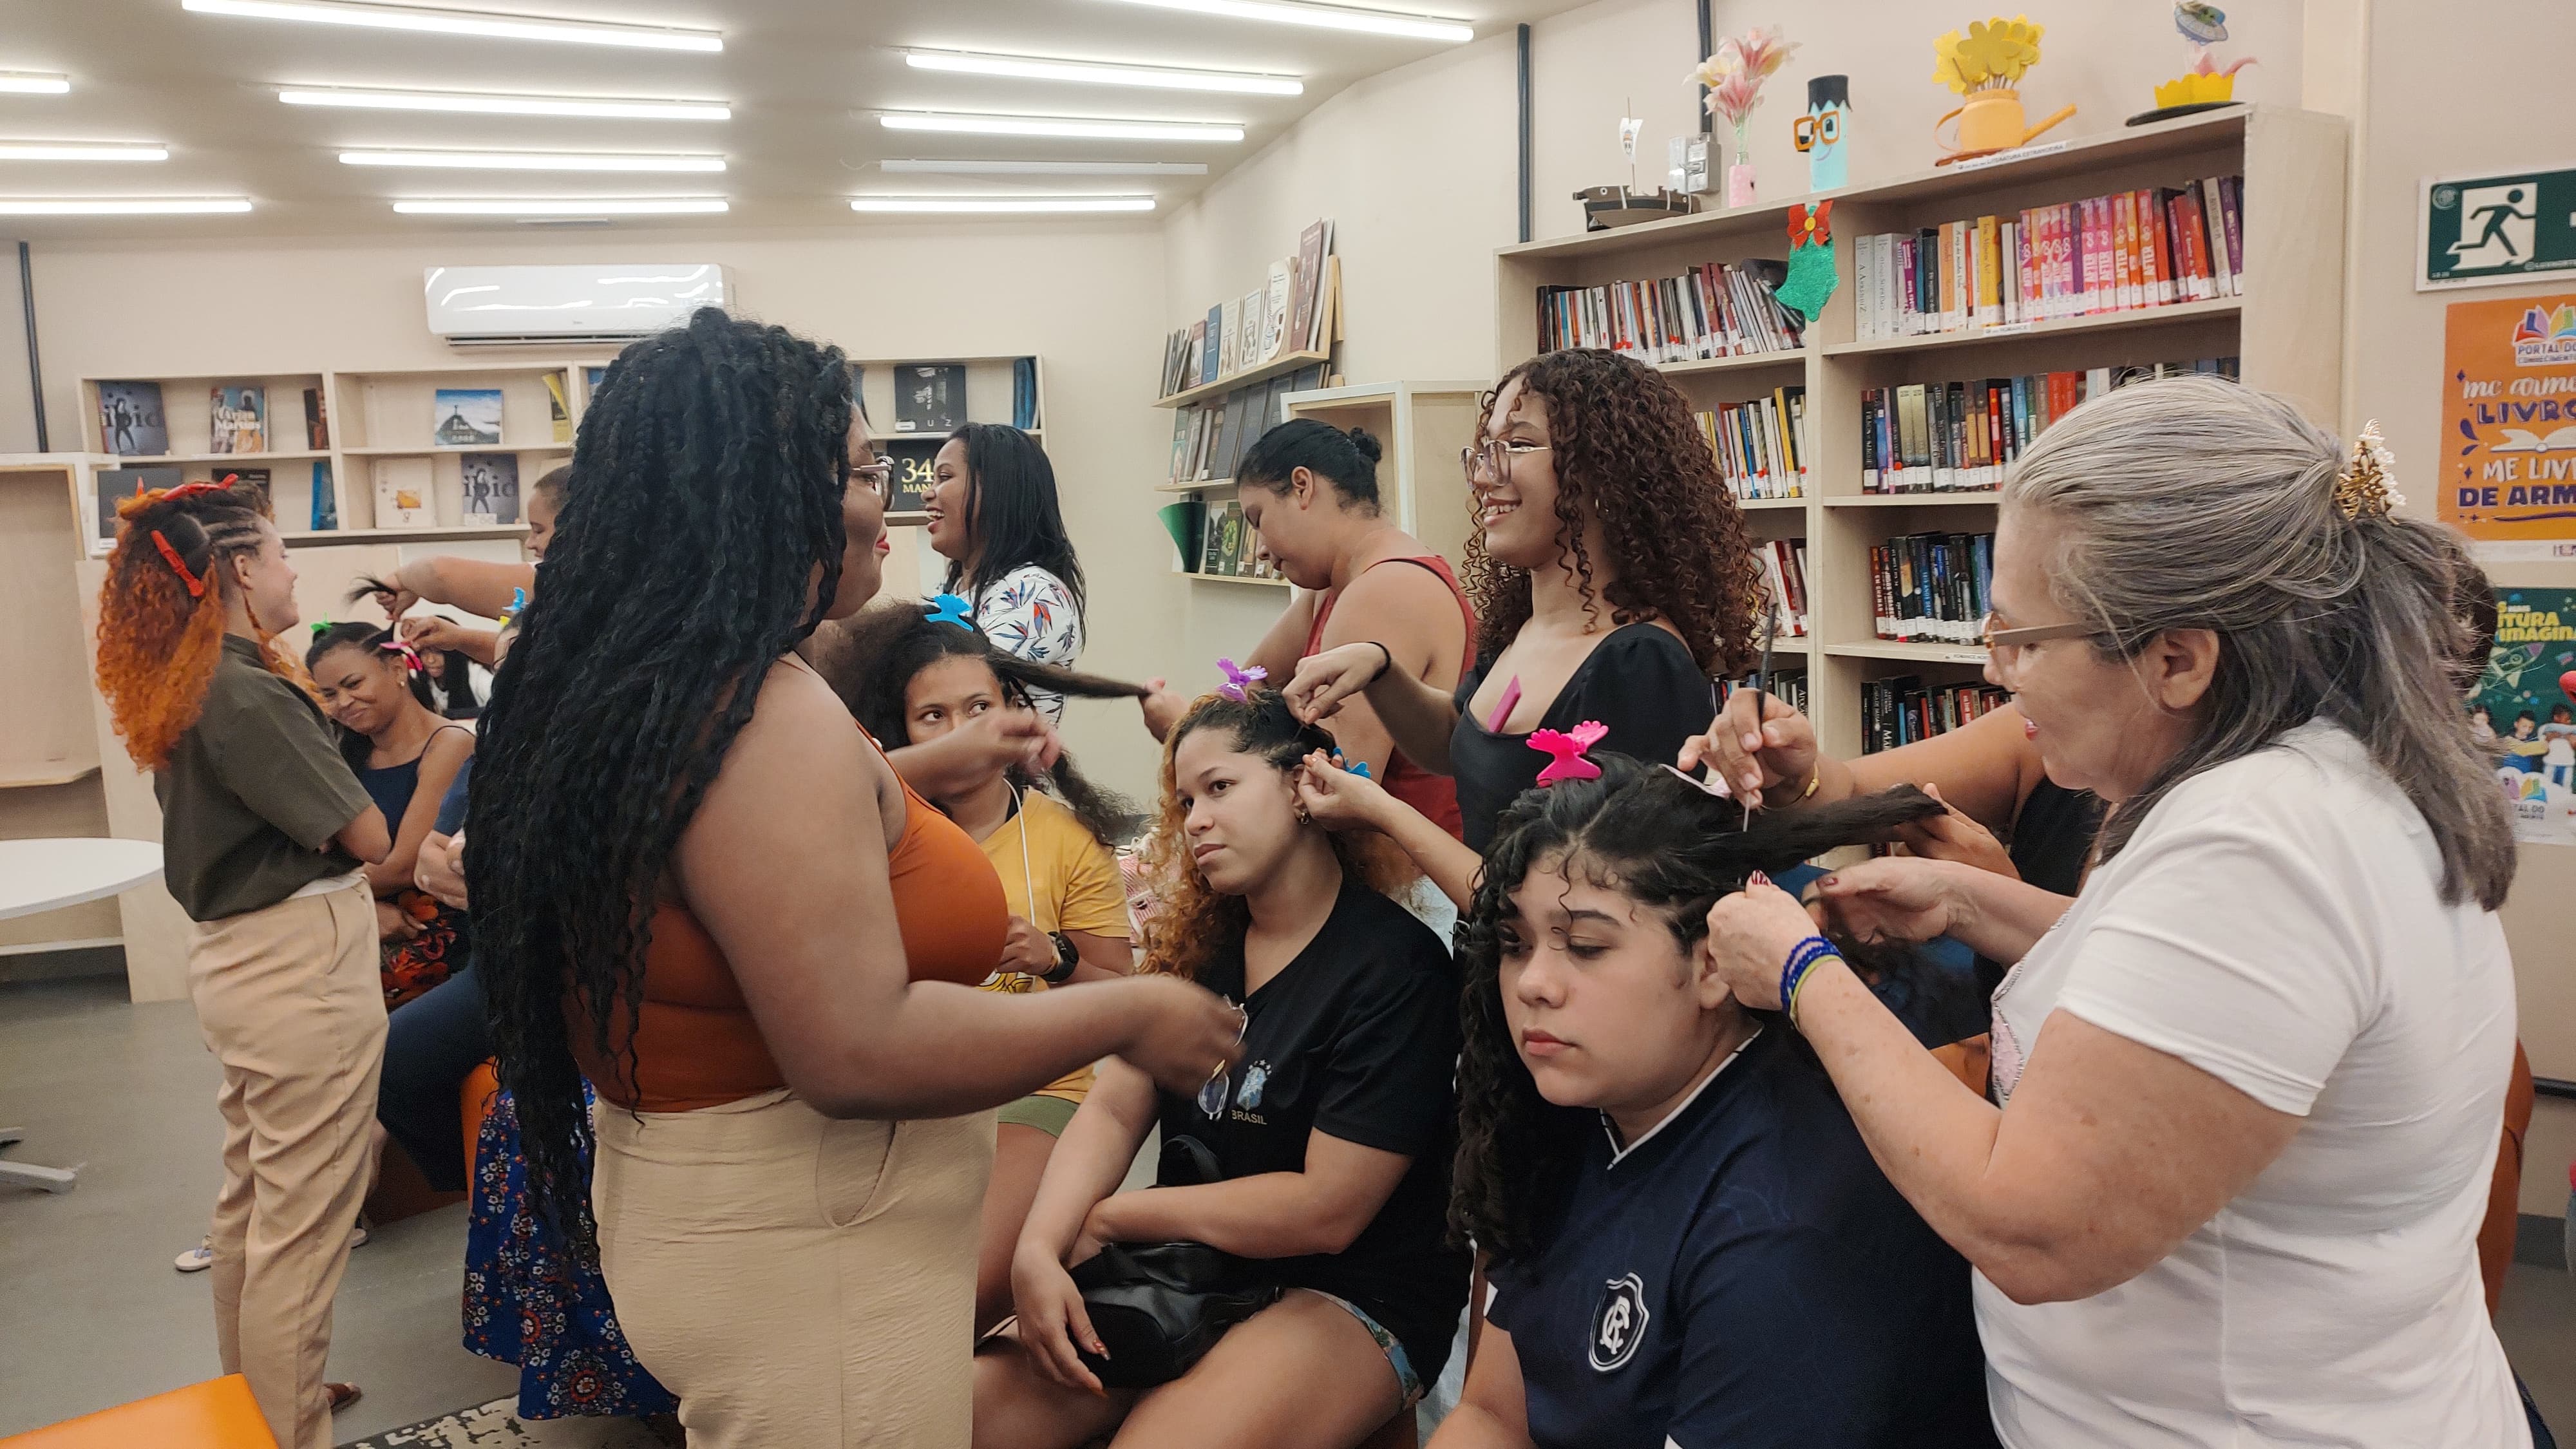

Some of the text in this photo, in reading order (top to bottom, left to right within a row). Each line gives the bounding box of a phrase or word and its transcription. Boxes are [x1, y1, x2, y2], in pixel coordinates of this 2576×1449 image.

[2518, 343, 2559, 355] PORTAL
[2483, 457, 2521, 483] ME
[2457, 487, 2499, 508] DE
[1231, 1110, 1268, 1126] BRASIL
